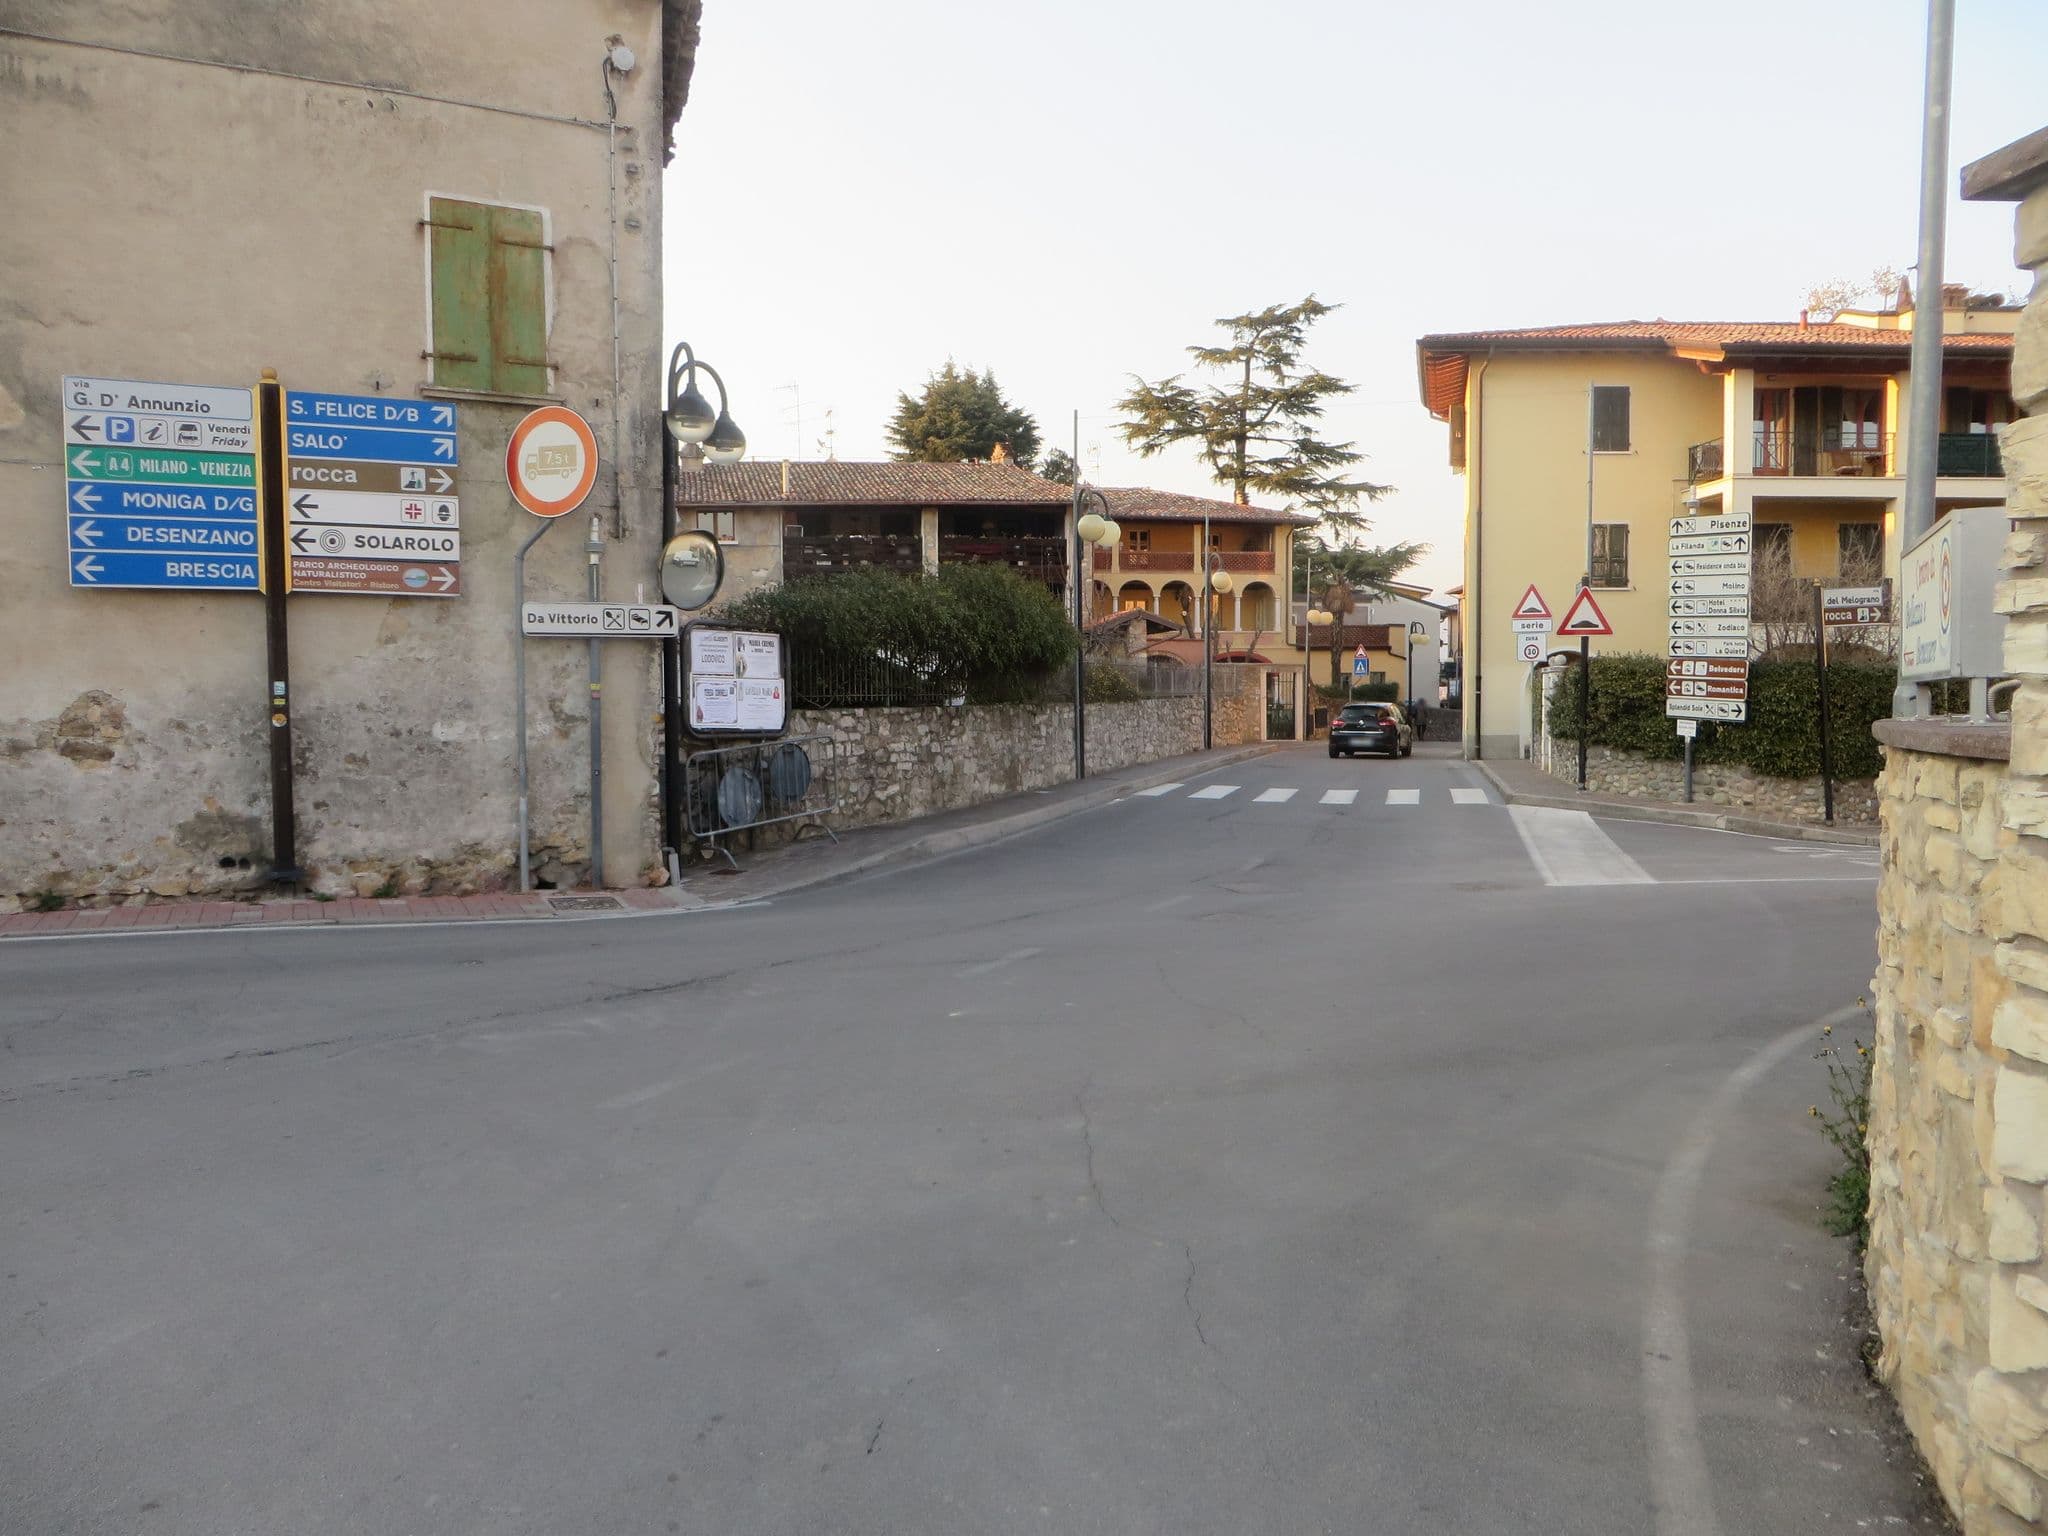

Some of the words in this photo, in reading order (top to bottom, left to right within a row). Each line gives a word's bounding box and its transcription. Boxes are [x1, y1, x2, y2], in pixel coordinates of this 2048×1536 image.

[73, 381, 90, 389] via
[73, 392, 93, 406] G.
[128, 395, 211, 414] Annunzio
[291, 400, 308, 415] S.
[315, 402, 377, 420] FELICE
[384, 406, 419, 422] D/B
[111, 419, 130, 440] P
[211, 436, 248, 448] Friday
[109, 457, 130, 471] A4
[139, 458, 188, 474] MILANO
[200, 461, 252, 478] VENEZIA
[292, 466, 358, 483] rocca
[122, 492, 206, 510] MONIGA
[214, 496, 254, 511] D/G
[1711, 520, 1747, 529] Pisenze
[127, 526, 254, 546] DESENZANO
[354, 535, 454, 552] SOLAROLO
[166, 562, 255, 579] BRESCIA
[293, 561, 325, 569] PARCO
[327, 562, 399, 572] ARCHEOLOGICO
[293, 570, 367, 579] NATURALISTICO
[1841, 596, 1879, 604] Melograno
[527, 613, 544, 624] Da
[548, 613, 598, 625] Vittorio
[1825, 611, 1852, 620] rocca
[1521, 621, 1544, 629] serie
[1708, 665, 1745, 674] Belvedere
[1708, 685, 1744, 694] Romantica
